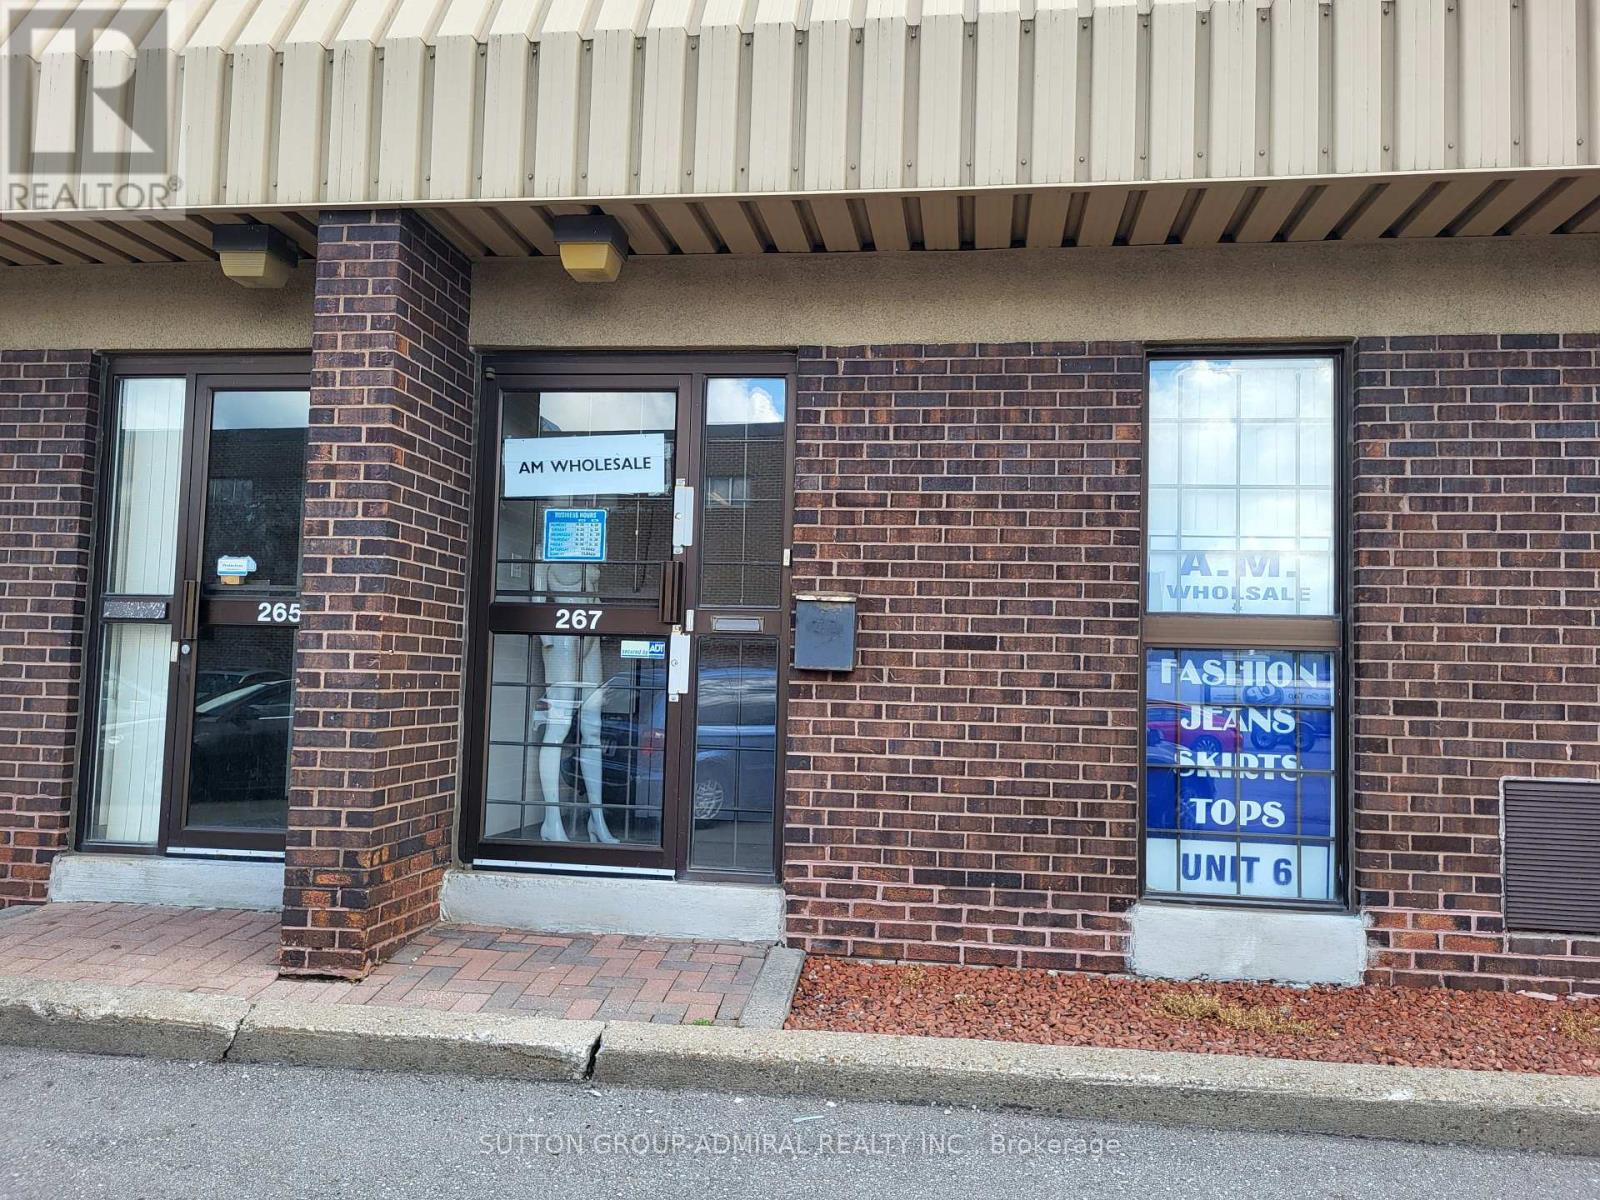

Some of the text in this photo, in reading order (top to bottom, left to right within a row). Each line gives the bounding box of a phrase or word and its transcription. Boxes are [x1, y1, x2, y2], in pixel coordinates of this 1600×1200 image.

[519, 456, 652, 474] AM WHOLESALE
[257, 602, 301, 622] 265
[555, 609, 602, 630] 267
[650, 645, 664, 654] ADT
[1161, 659, 1317, 688] FASHION
[1180, 704, 1296, 734] JEANS
[1173, 751, 1303, 782] SKIRTS
[1190, 798, 1286, 828] TOPS
[1181, 853, 1292, 886] UNIT 6
